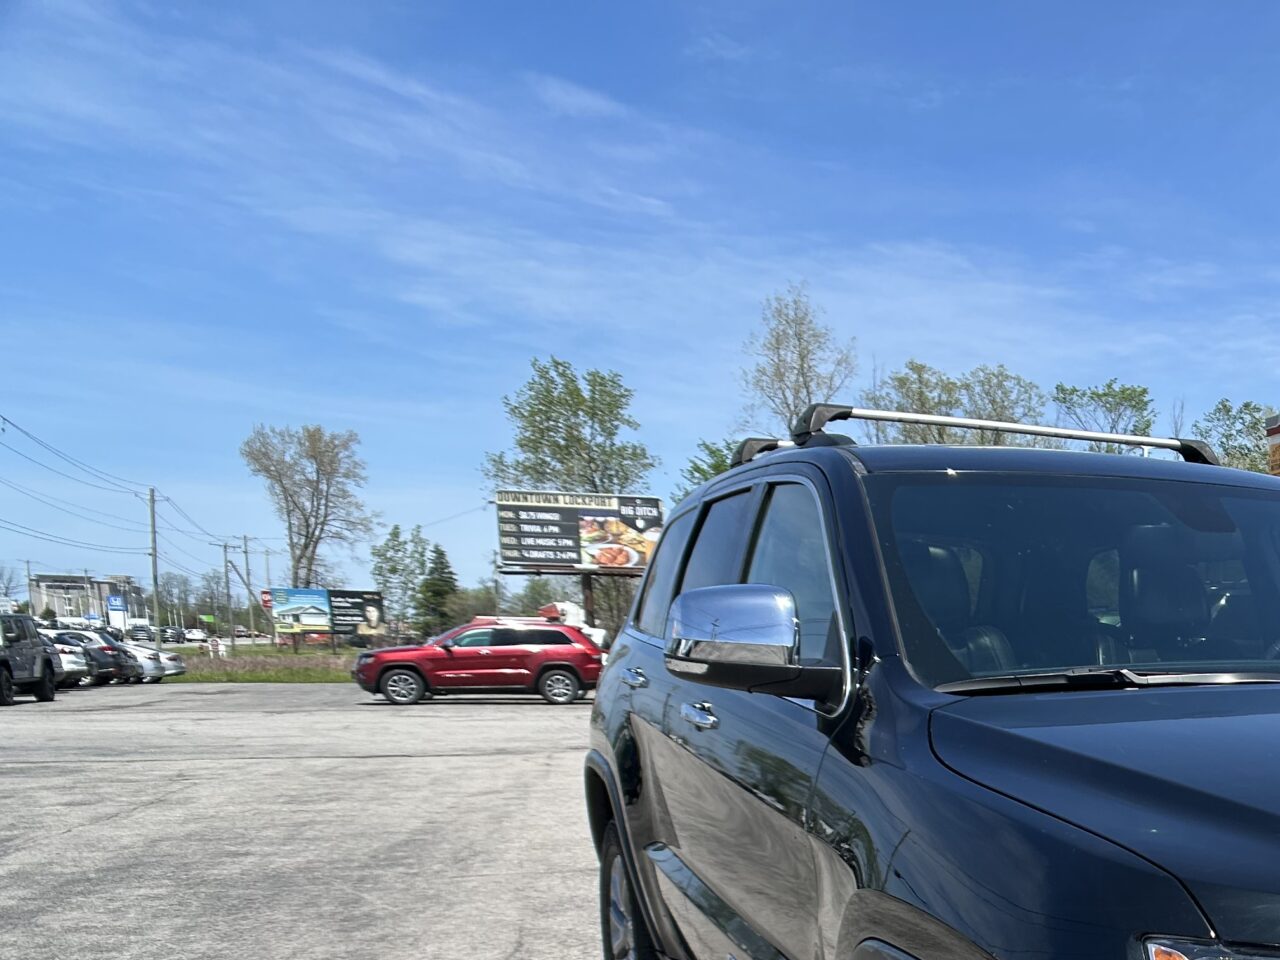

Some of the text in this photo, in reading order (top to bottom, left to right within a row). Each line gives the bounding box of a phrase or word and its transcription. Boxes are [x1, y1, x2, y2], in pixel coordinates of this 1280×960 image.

[497, 491, 613, 507] DOWNTOWN LOCKPORT
[620, 505, 659, 516] BIG DITCH
[520, 537, 535, 546] LIVE
